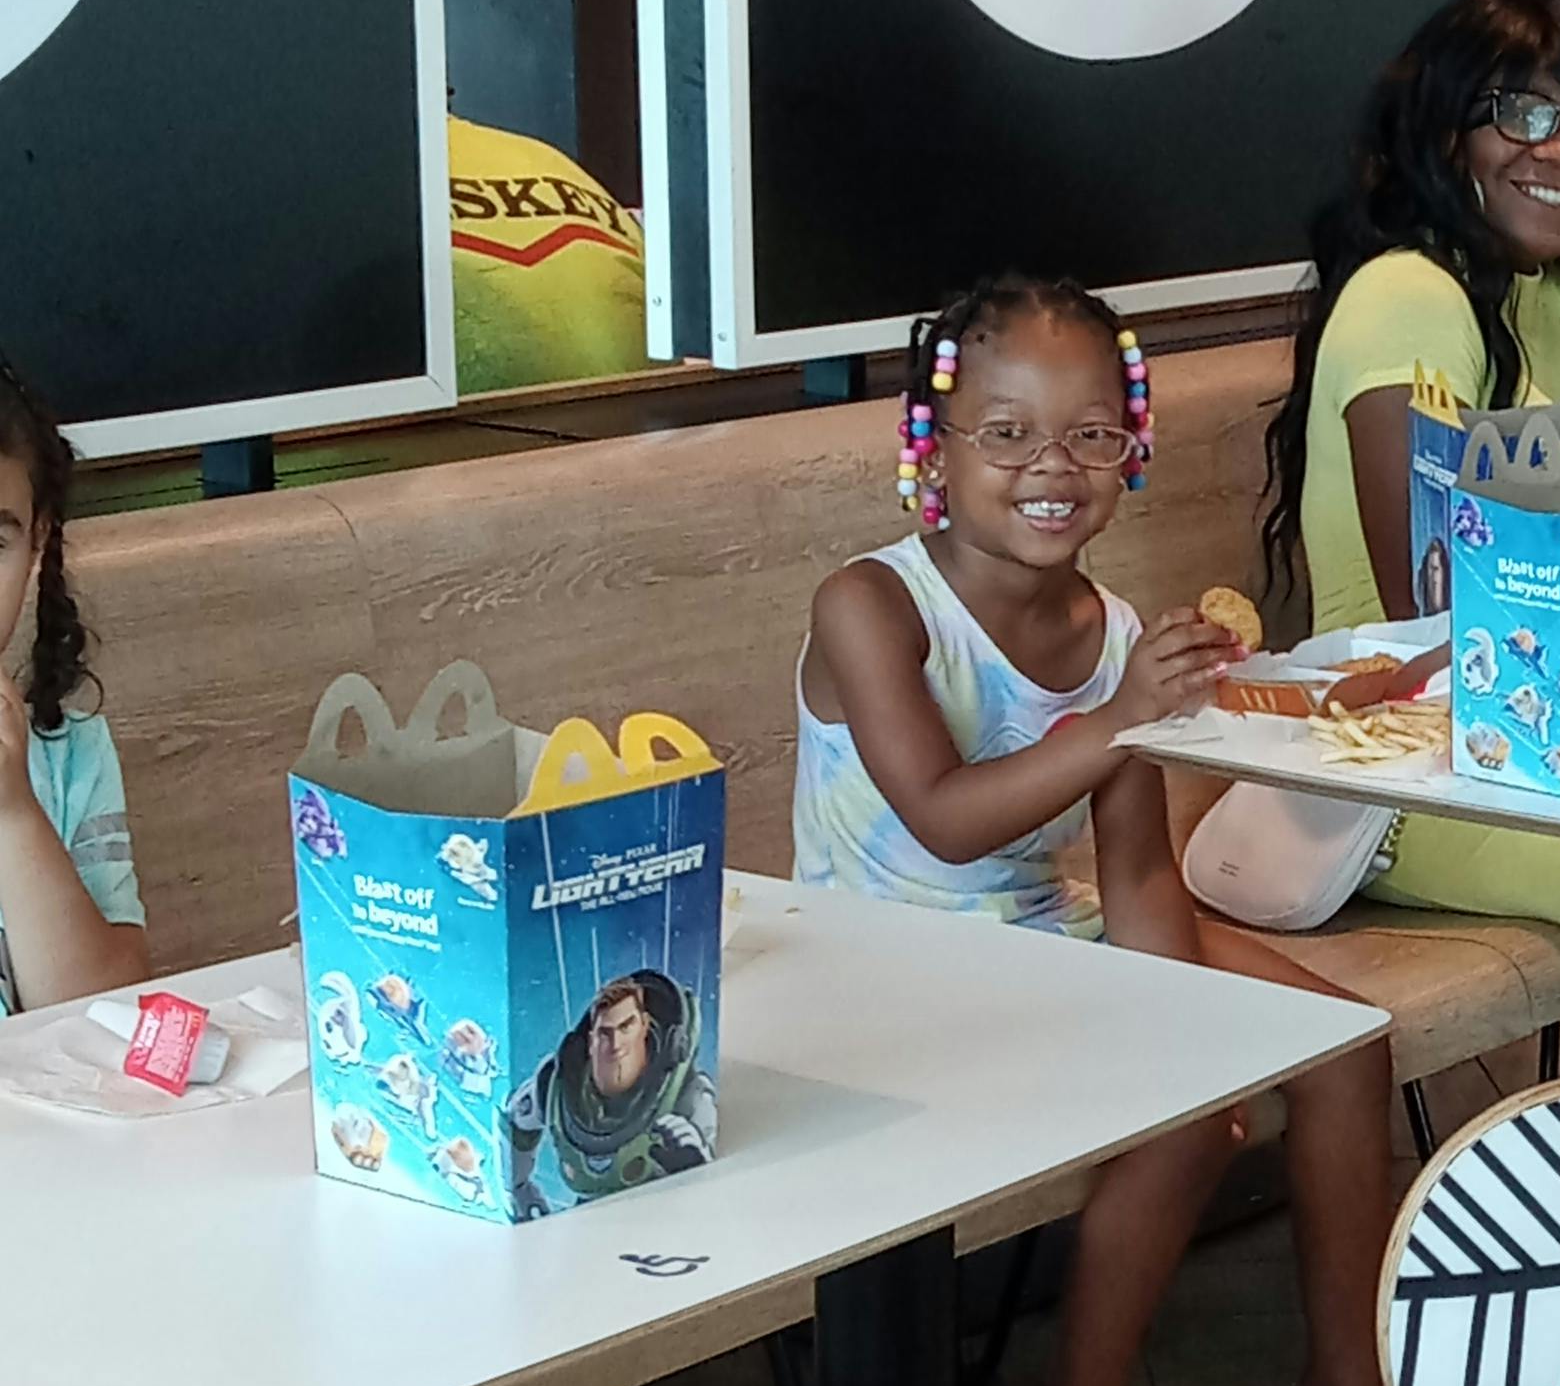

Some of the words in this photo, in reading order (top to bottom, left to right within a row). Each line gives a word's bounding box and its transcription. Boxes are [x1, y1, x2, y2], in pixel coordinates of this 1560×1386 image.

[450, 176, 628, 237] SKEY
[1507, 576, 1560, 601] beyond
[1536, 564, 1559, 582] off
[353, 874, 403, 904] Blast
[404, 888, 434, 909] off
[368, 900, 438, 936] beyond
